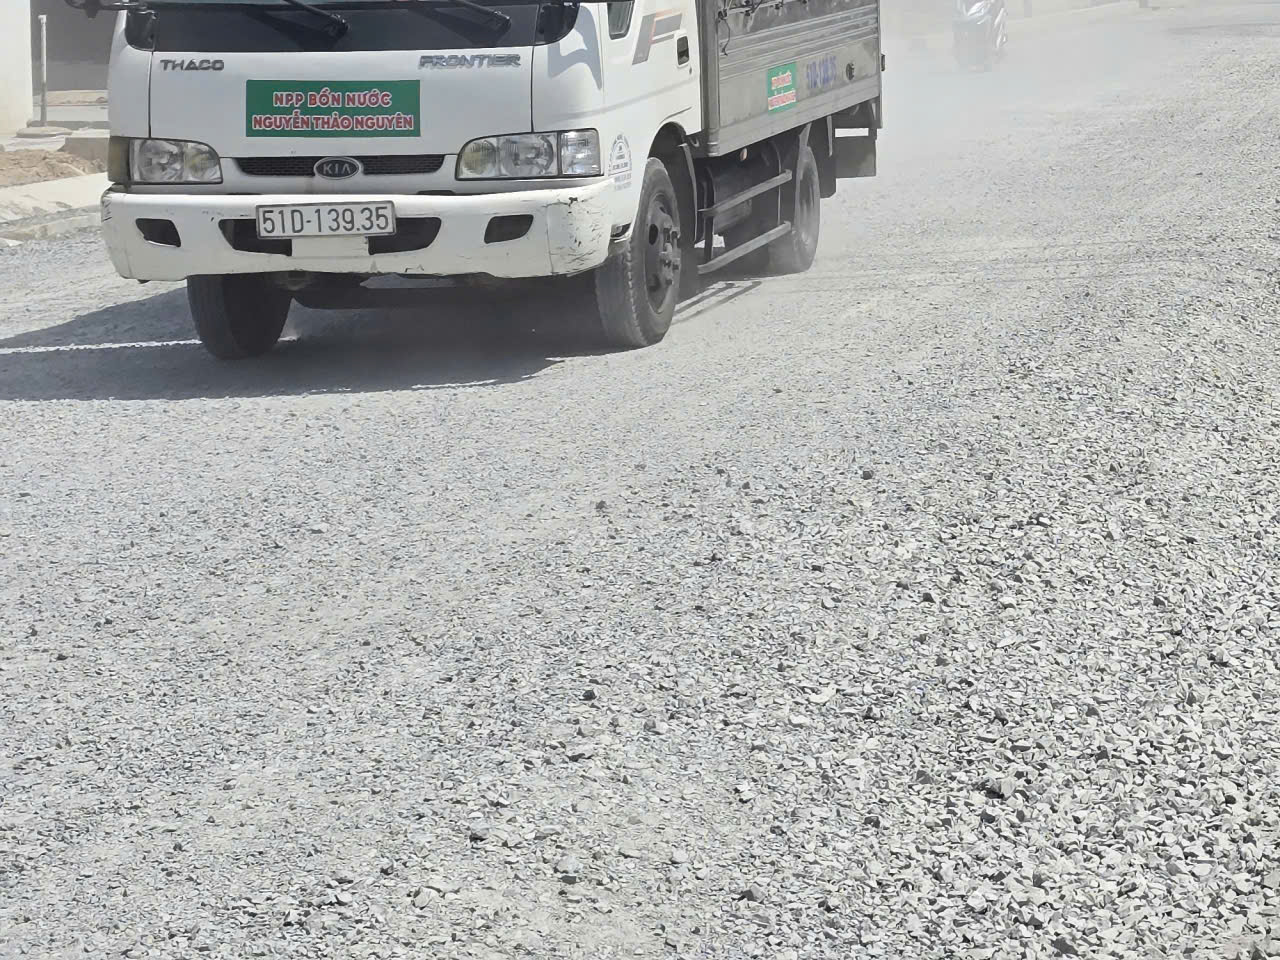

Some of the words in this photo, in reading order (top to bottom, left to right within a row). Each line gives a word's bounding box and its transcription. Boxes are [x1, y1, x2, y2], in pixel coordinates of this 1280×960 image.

[160, 59, 225, 71] THACO
[419, 54, 521, 68] FRONTIER
[273, 92, 304, 107] NPP
[345, 89, 392, 107] NƯỚC
[252, 109, 311, 130] NGUYỄN
[312, 112, 352, 130] THẢO
[354, 112, 414, 130] NGUYÊN
[323, 163, 351, 174] KIA
[262, 206, 389, 234] 51D-139.35
